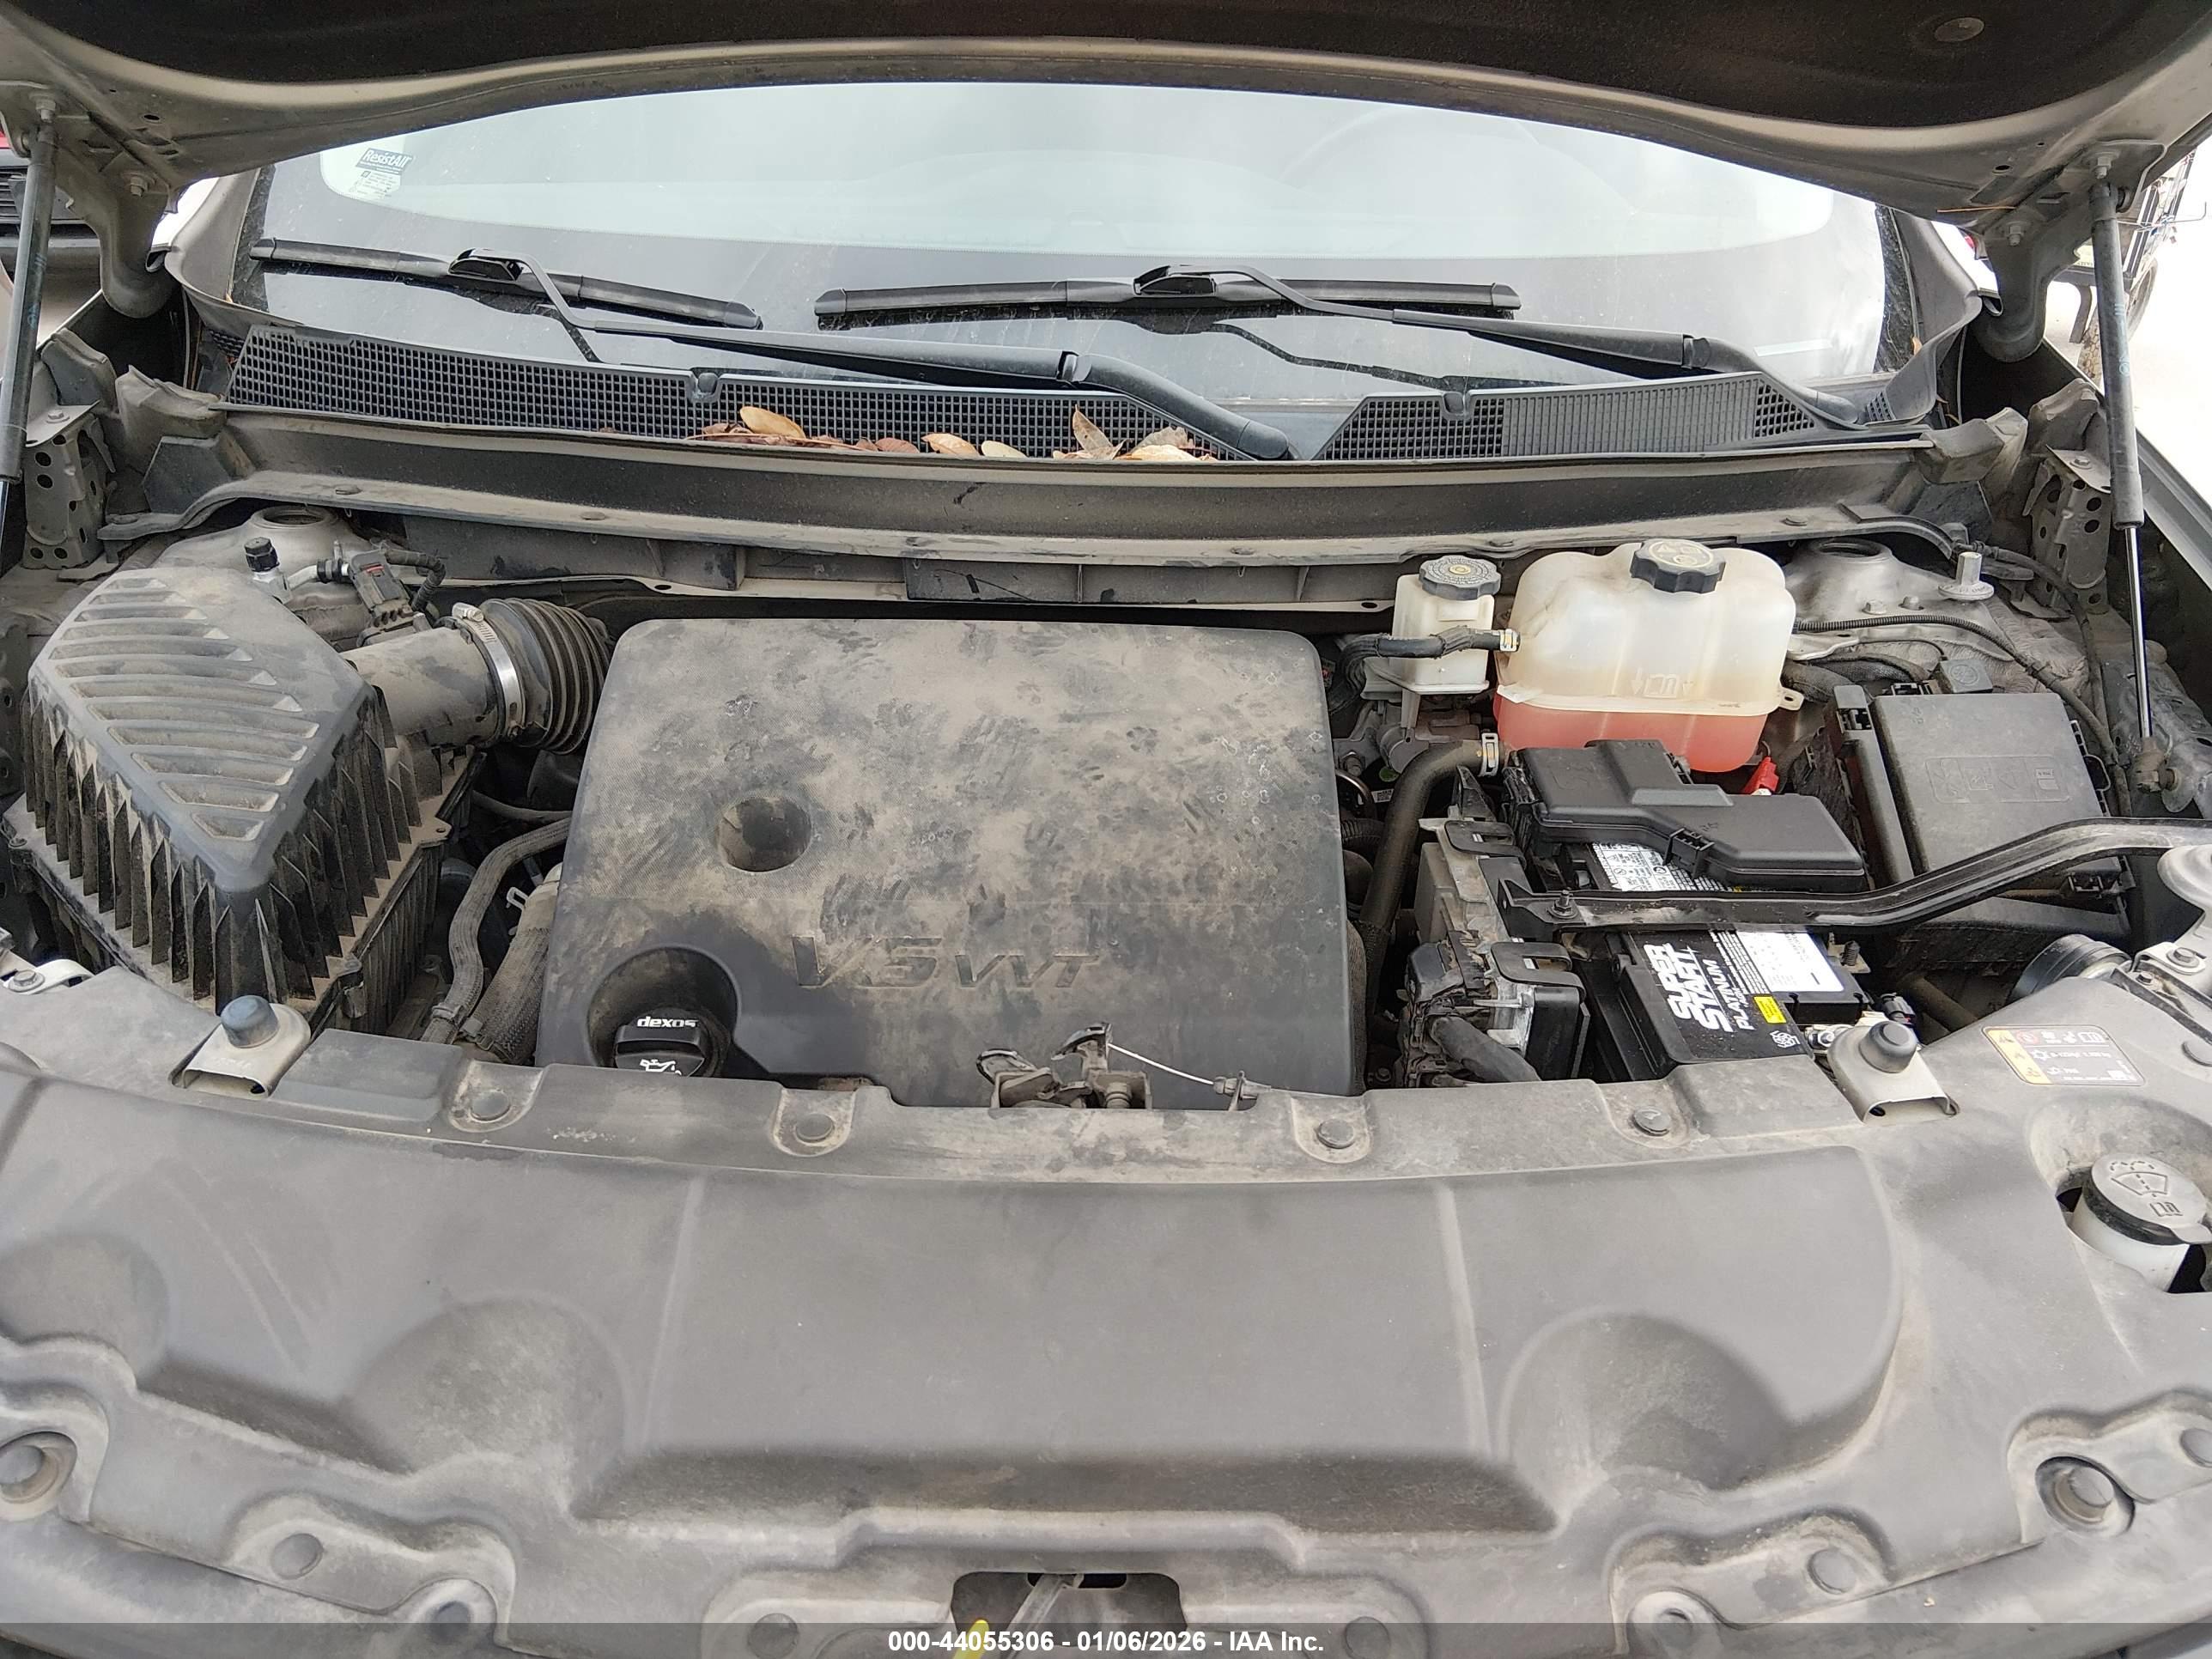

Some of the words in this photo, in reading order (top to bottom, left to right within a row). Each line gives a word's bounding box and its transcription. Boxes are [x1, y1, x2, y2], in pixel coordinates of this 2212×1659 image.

[954, 953, 1100, 988] VVT
[1643, 943, 1692, 1020] SUPER
[1662, 942, 1734, 1033] START
[1702, 958, 1756, 1030] PLATINUM
[636, 1016, 699, 1028] dexos
